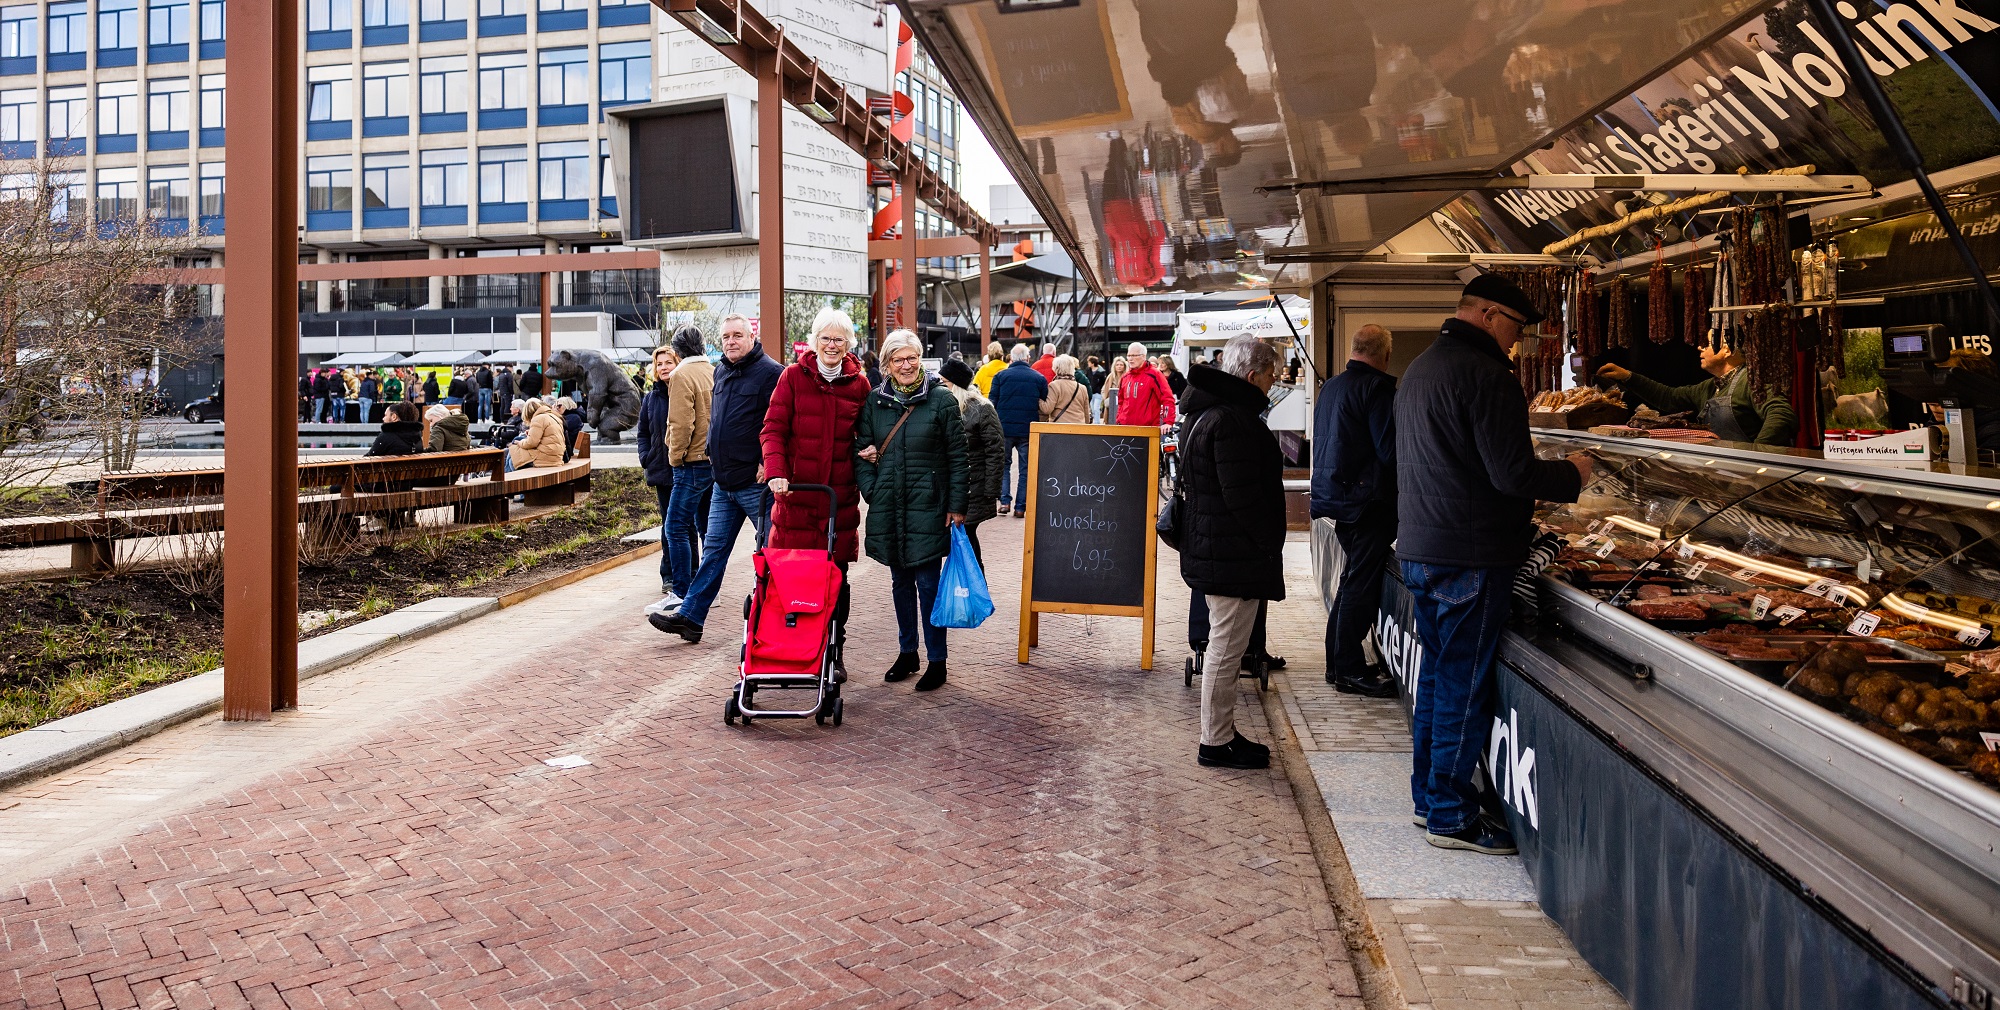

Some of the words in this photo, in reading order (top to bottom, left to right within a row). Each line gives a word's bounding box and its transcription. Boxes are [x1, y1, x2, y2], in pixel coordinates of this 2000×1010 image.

[795, 7, 840, 34] BRINK
[817, 59, 850, 79] RINK
[1605, 75, 1780, 175] Slagerij
[806, 142, 850, 163] BRINK
[797, 185, 842, 204] BRINK
[807, 231, 851, 248] BRINK
[798, 274, 843, 290] BRINK
[1828, 444, 1864, 456] Verstegen
[1866, 445, 1899, 455] Kruiden
[1046, 476, 1061, 498] 3
